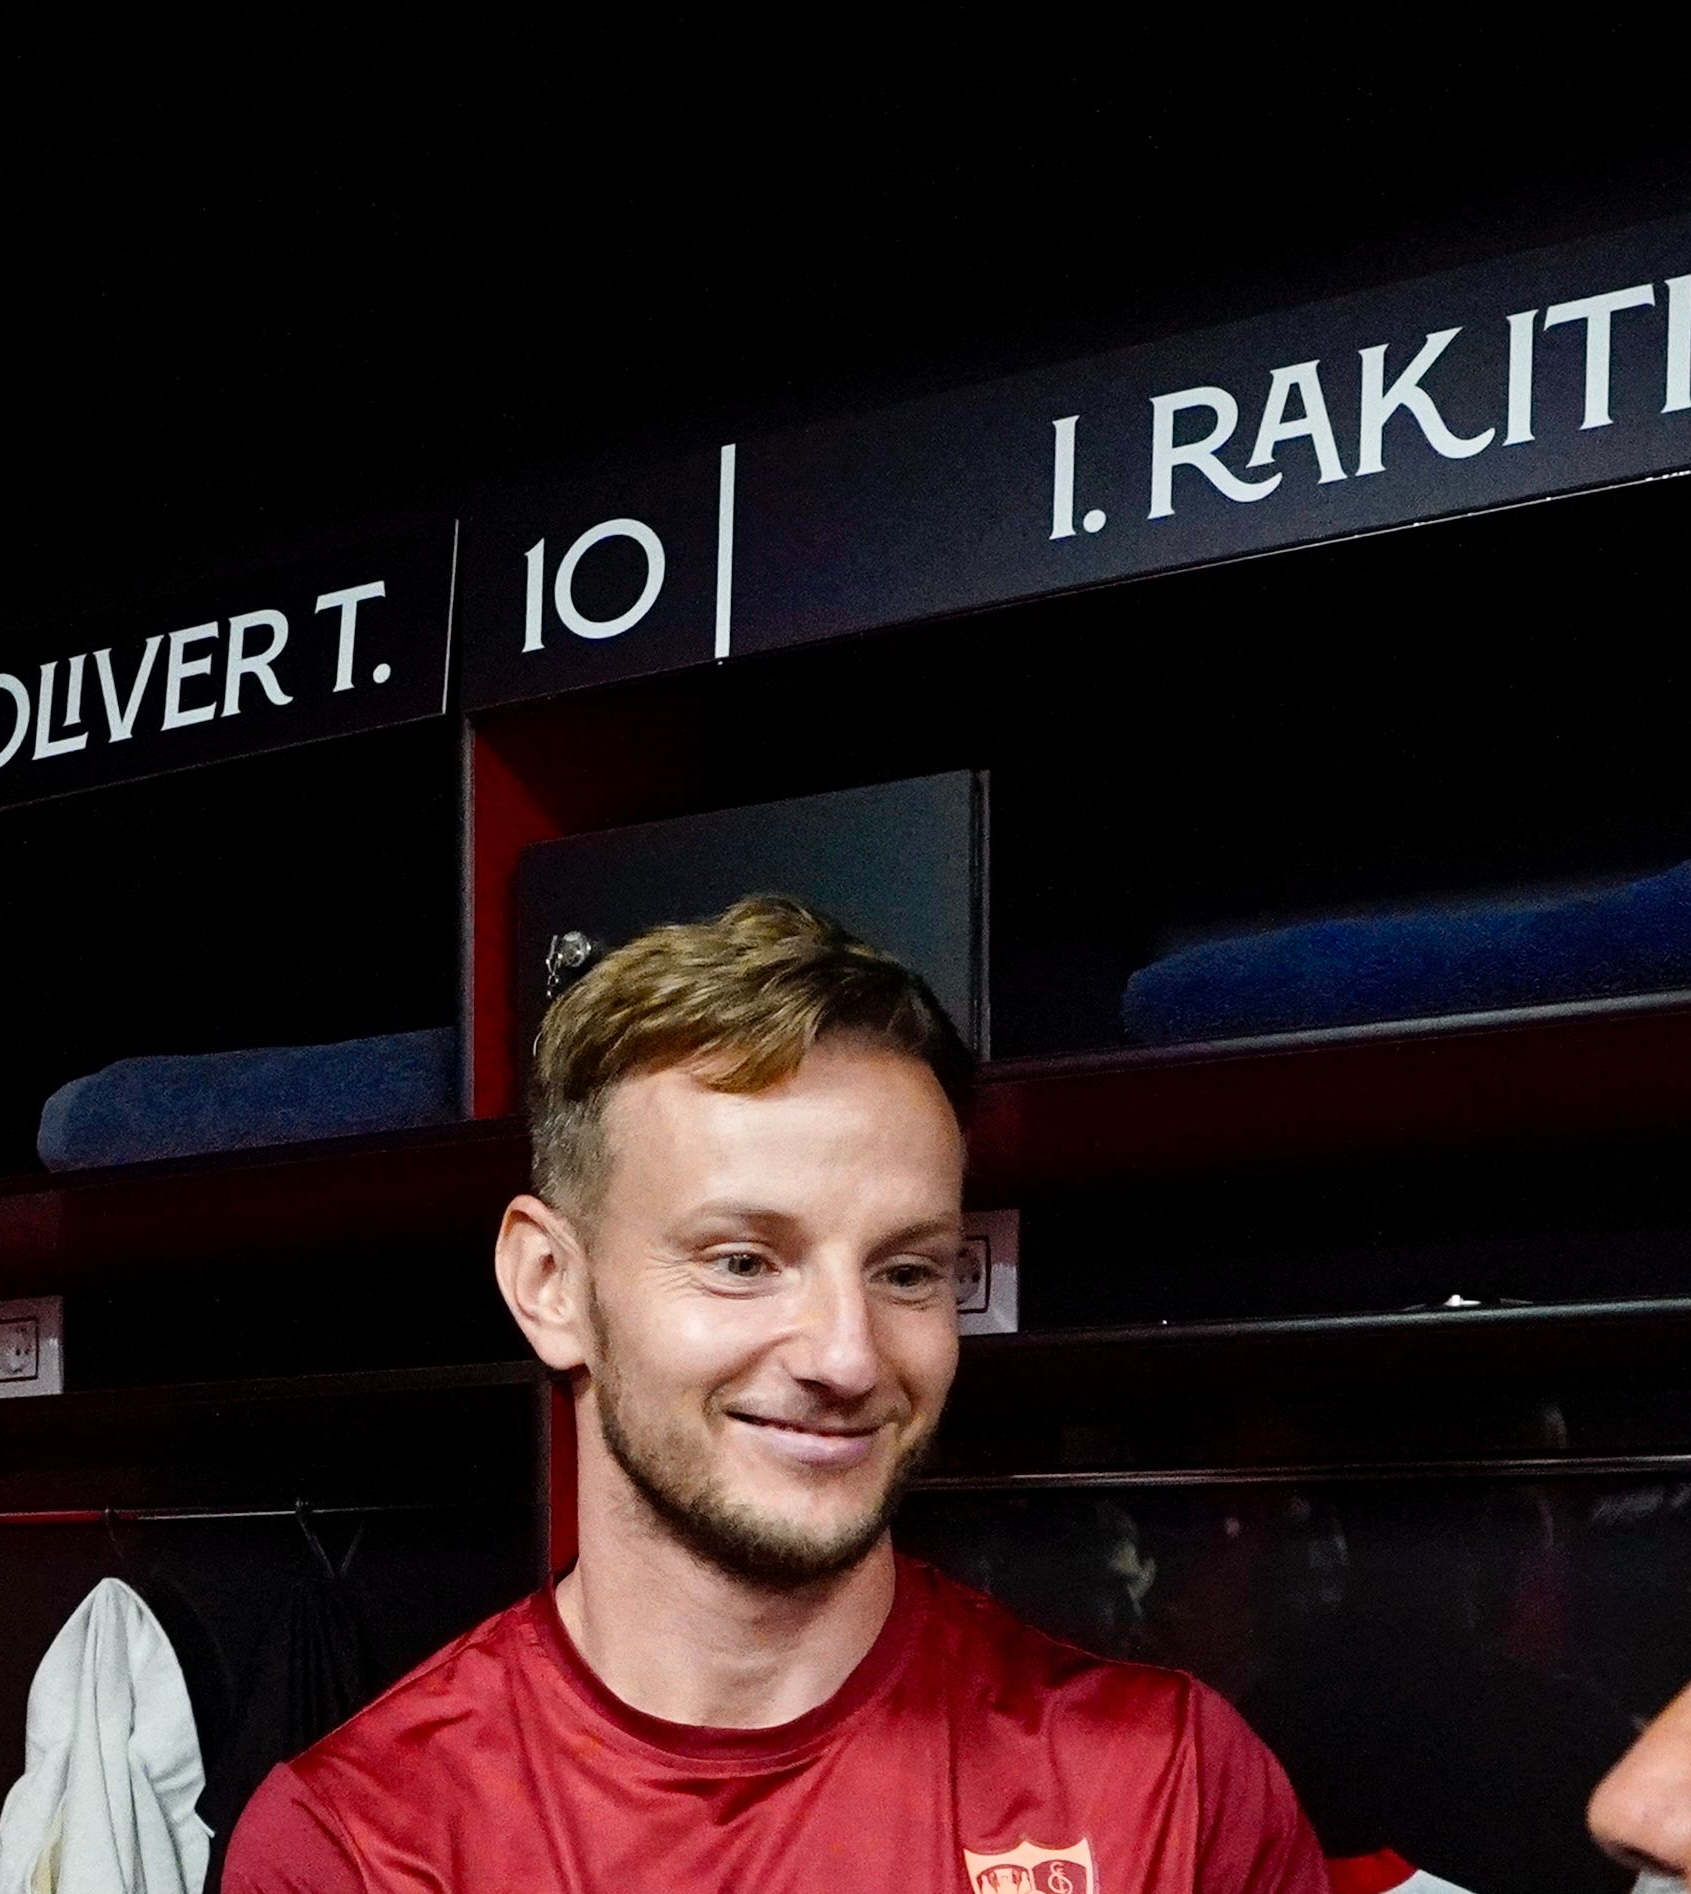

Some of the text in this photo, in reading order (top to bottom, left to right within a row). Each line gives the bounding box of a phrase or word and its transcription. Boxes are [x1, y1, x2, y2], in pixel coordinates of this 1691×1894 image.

[1048, 414, 1107, 541] I.
[314, 580, 391, 693] T.
[521, 518, 666, 653] 10
